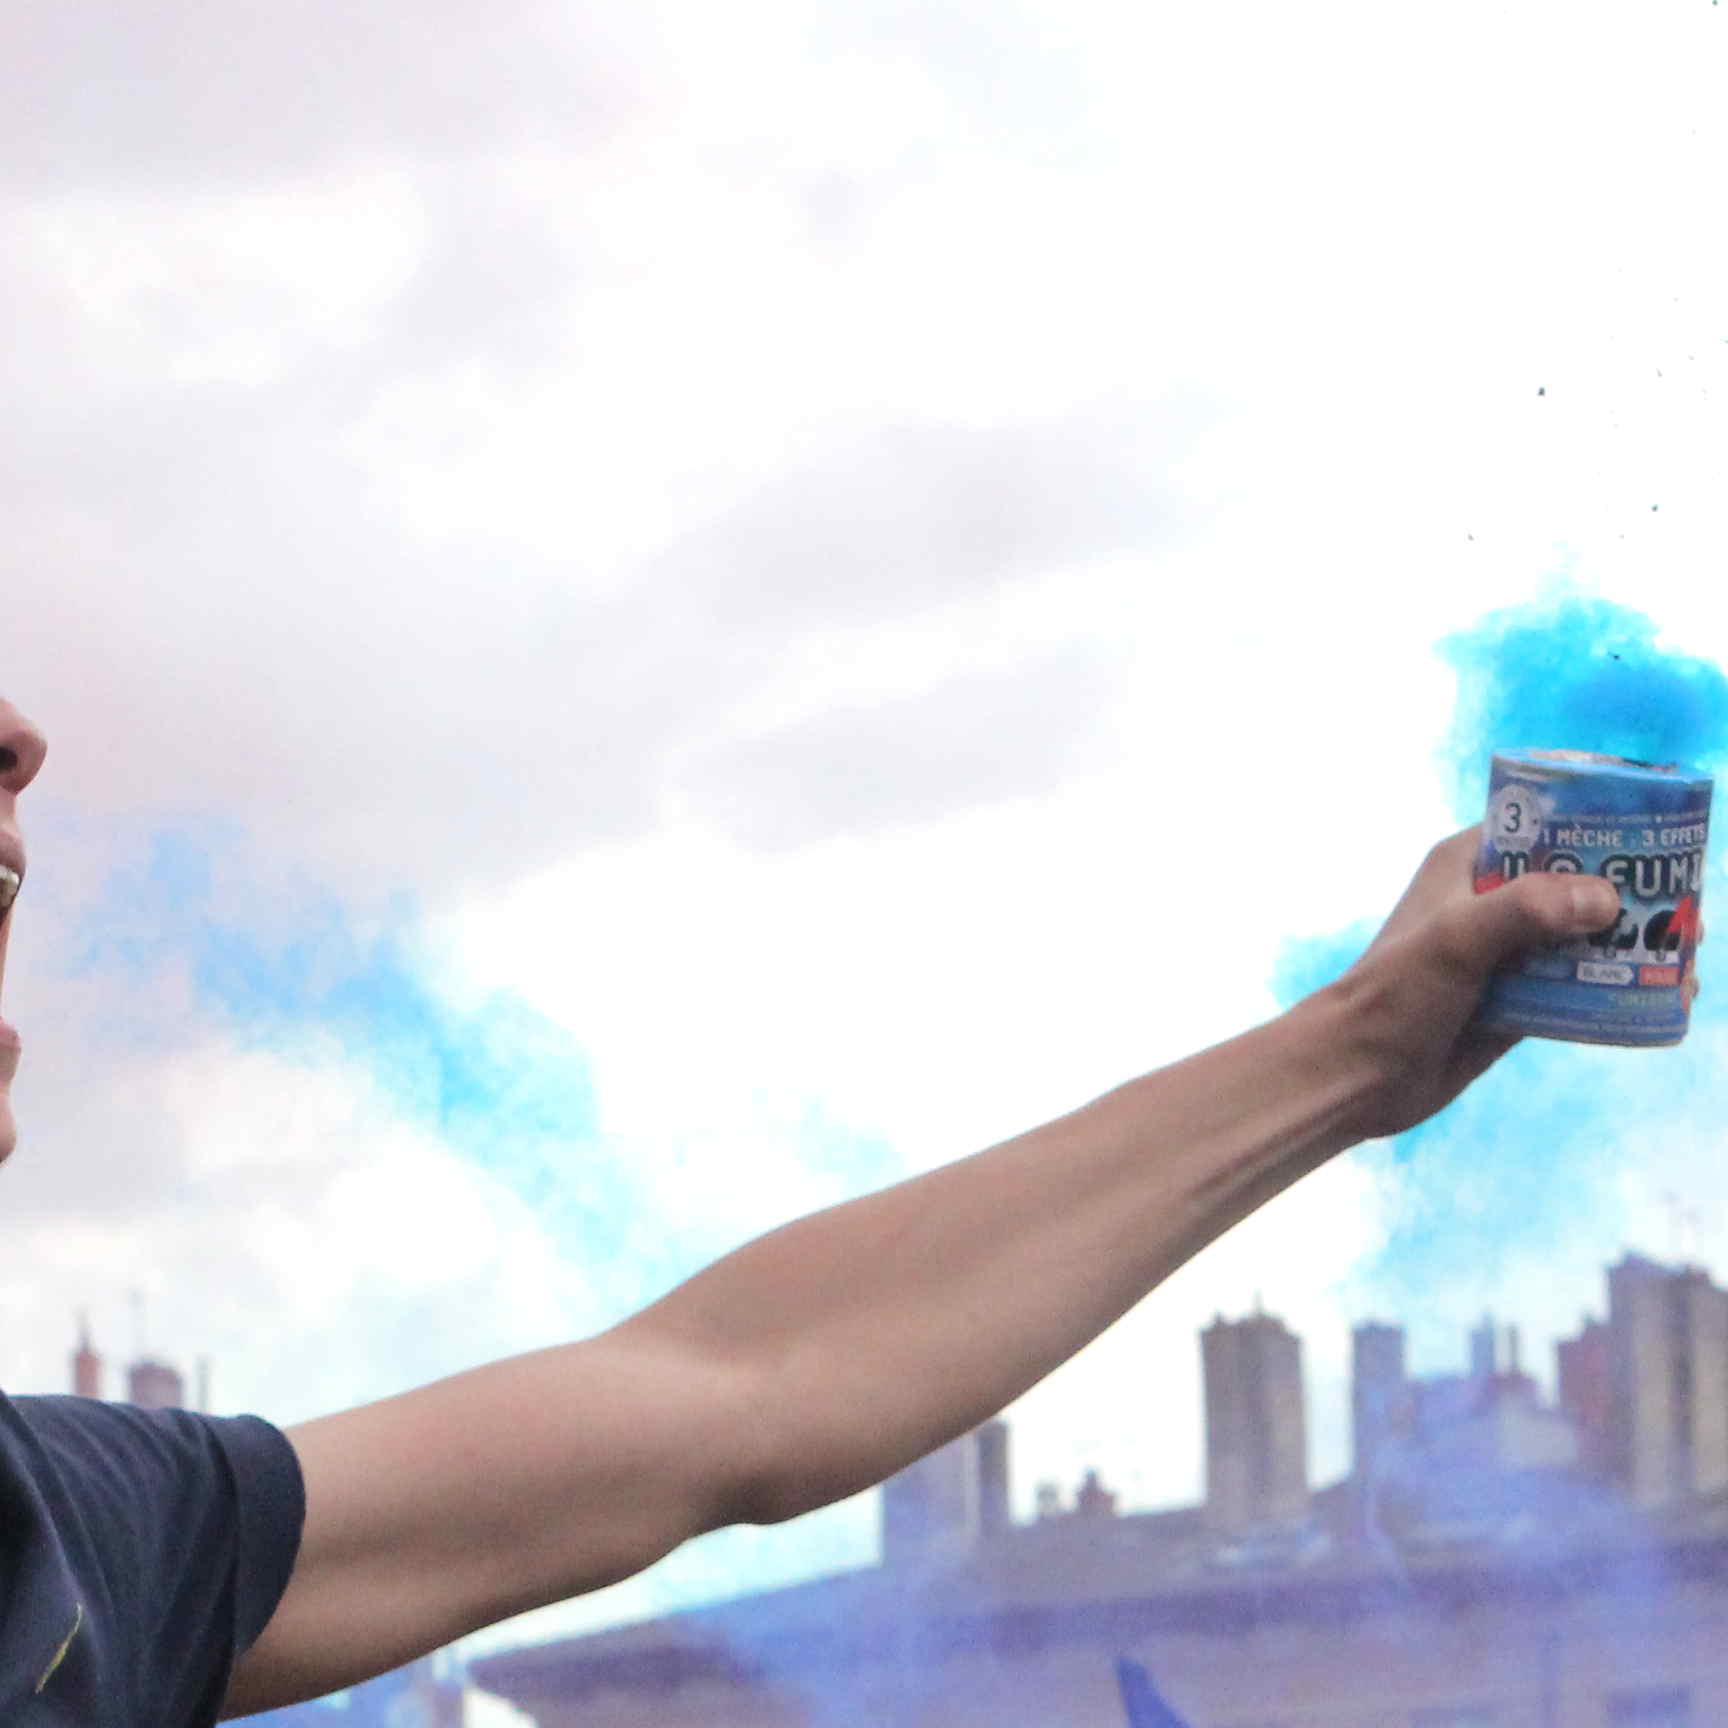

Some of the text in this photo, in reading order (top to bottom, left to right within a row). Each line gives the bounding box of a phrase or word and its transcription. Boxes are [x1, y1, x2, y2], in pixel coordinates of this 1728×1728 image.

[1504, 802, 1522, 833] 3
[1556, 824, 1622, 848] MÈCHE
[1641, 829, 1654, 848] 3
